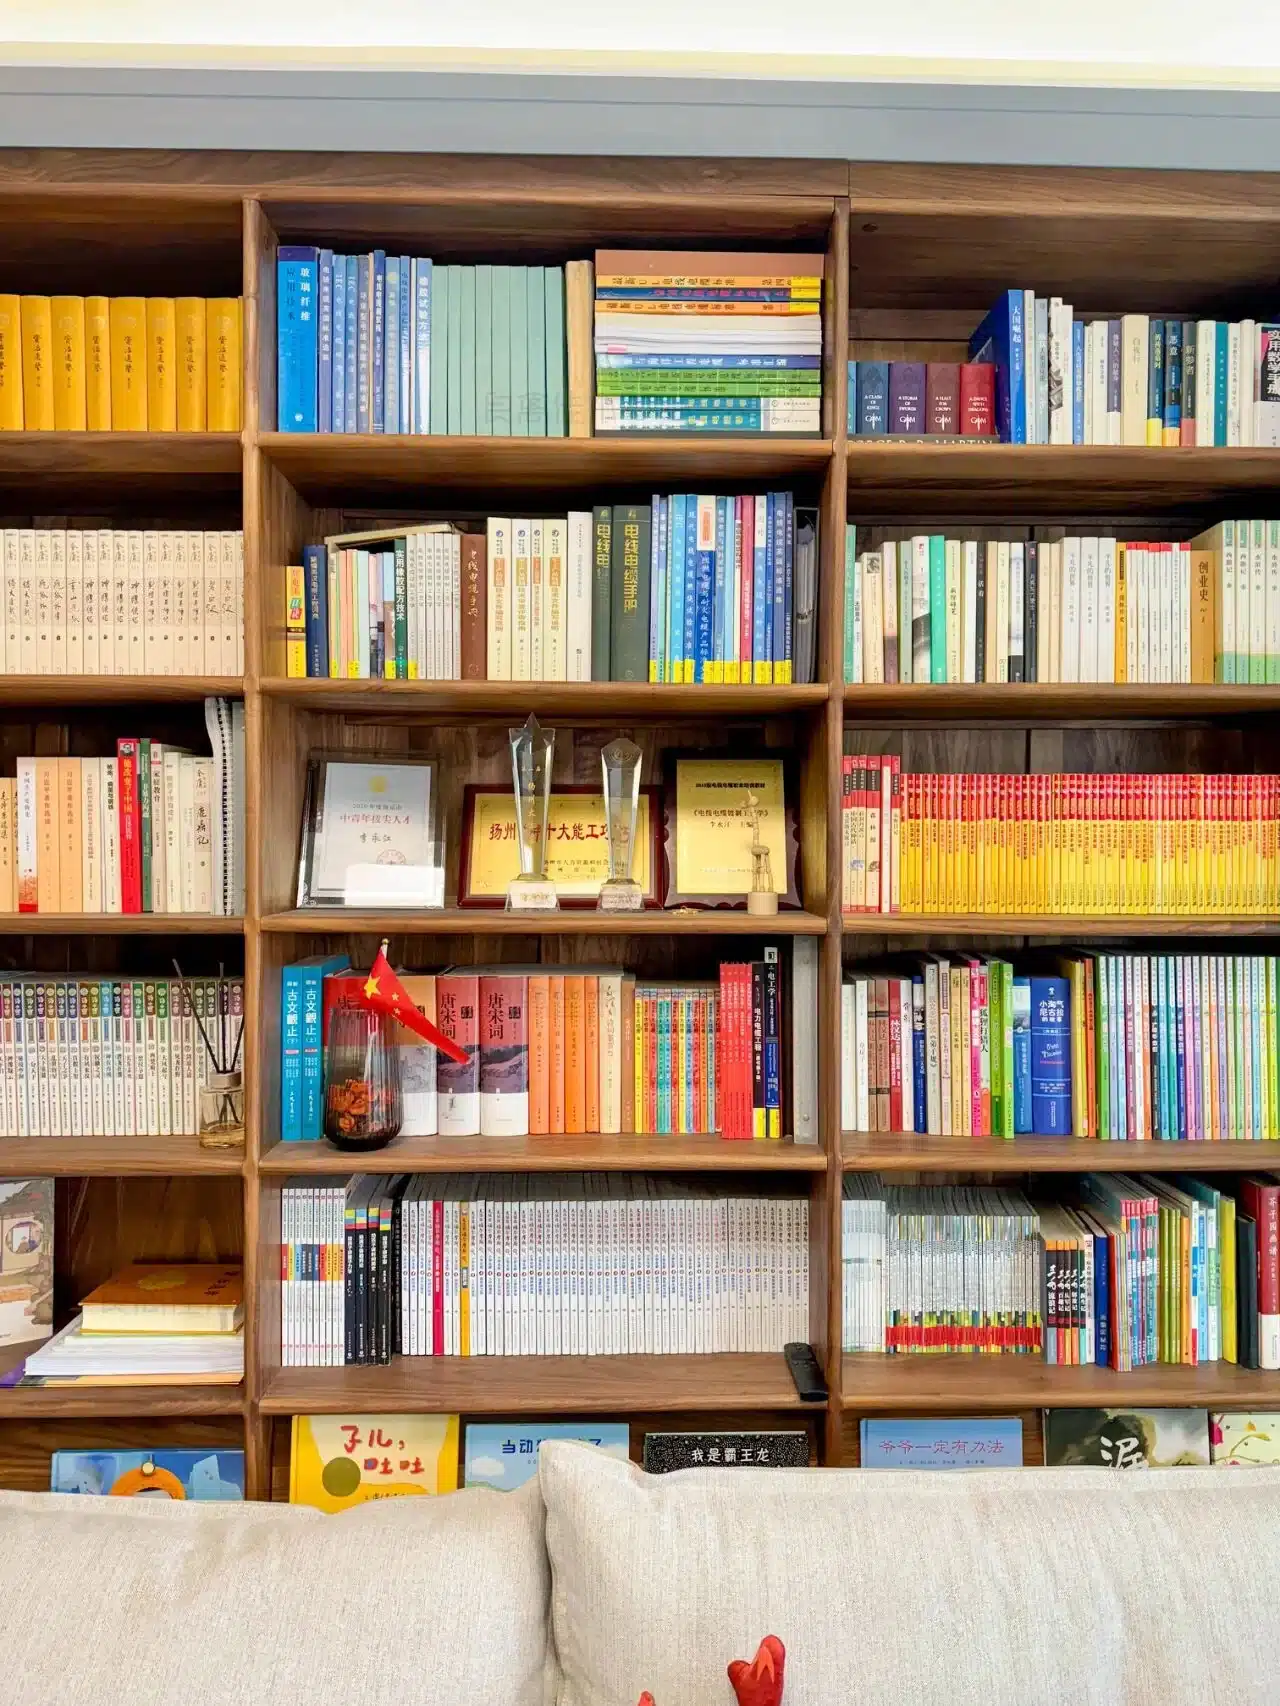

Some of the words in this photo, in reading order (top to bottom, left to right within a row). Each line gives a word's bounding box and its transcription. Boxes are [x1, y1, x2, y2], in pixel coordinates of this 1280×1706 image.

[300, 267, 311, 321] 玻璃纤维
[396, 550, 404, 621] 实用橡胶配方技术
[623, 523, 639, 613] 电线电缆手册
[1198, 561, 1208, 601] 创业史
[340, 813, 411, 825] 中青年拔尖人才
[767, 971, 775, 996] 电工学
[1039, 1000, 1065, 1009] 小淘气
[286, 989, 298, 1037] 古文觀止
[305, 988, 317, 1036] 古文觀止
[440, 992, 456, 1040] 唐宋词
[488, 992, 504, 1040] 唐宋词
[754, 1007, 762, 1052] 电力电缆工程
[1040, 1008, 1064, 1017] 尼古拉
[363, 1456, 425, 1475] 吐吐
[691, 1447, 770, 1463] 我是霸王龙
[879, 1439, 1004, 1455] 爷爷一定有办法
